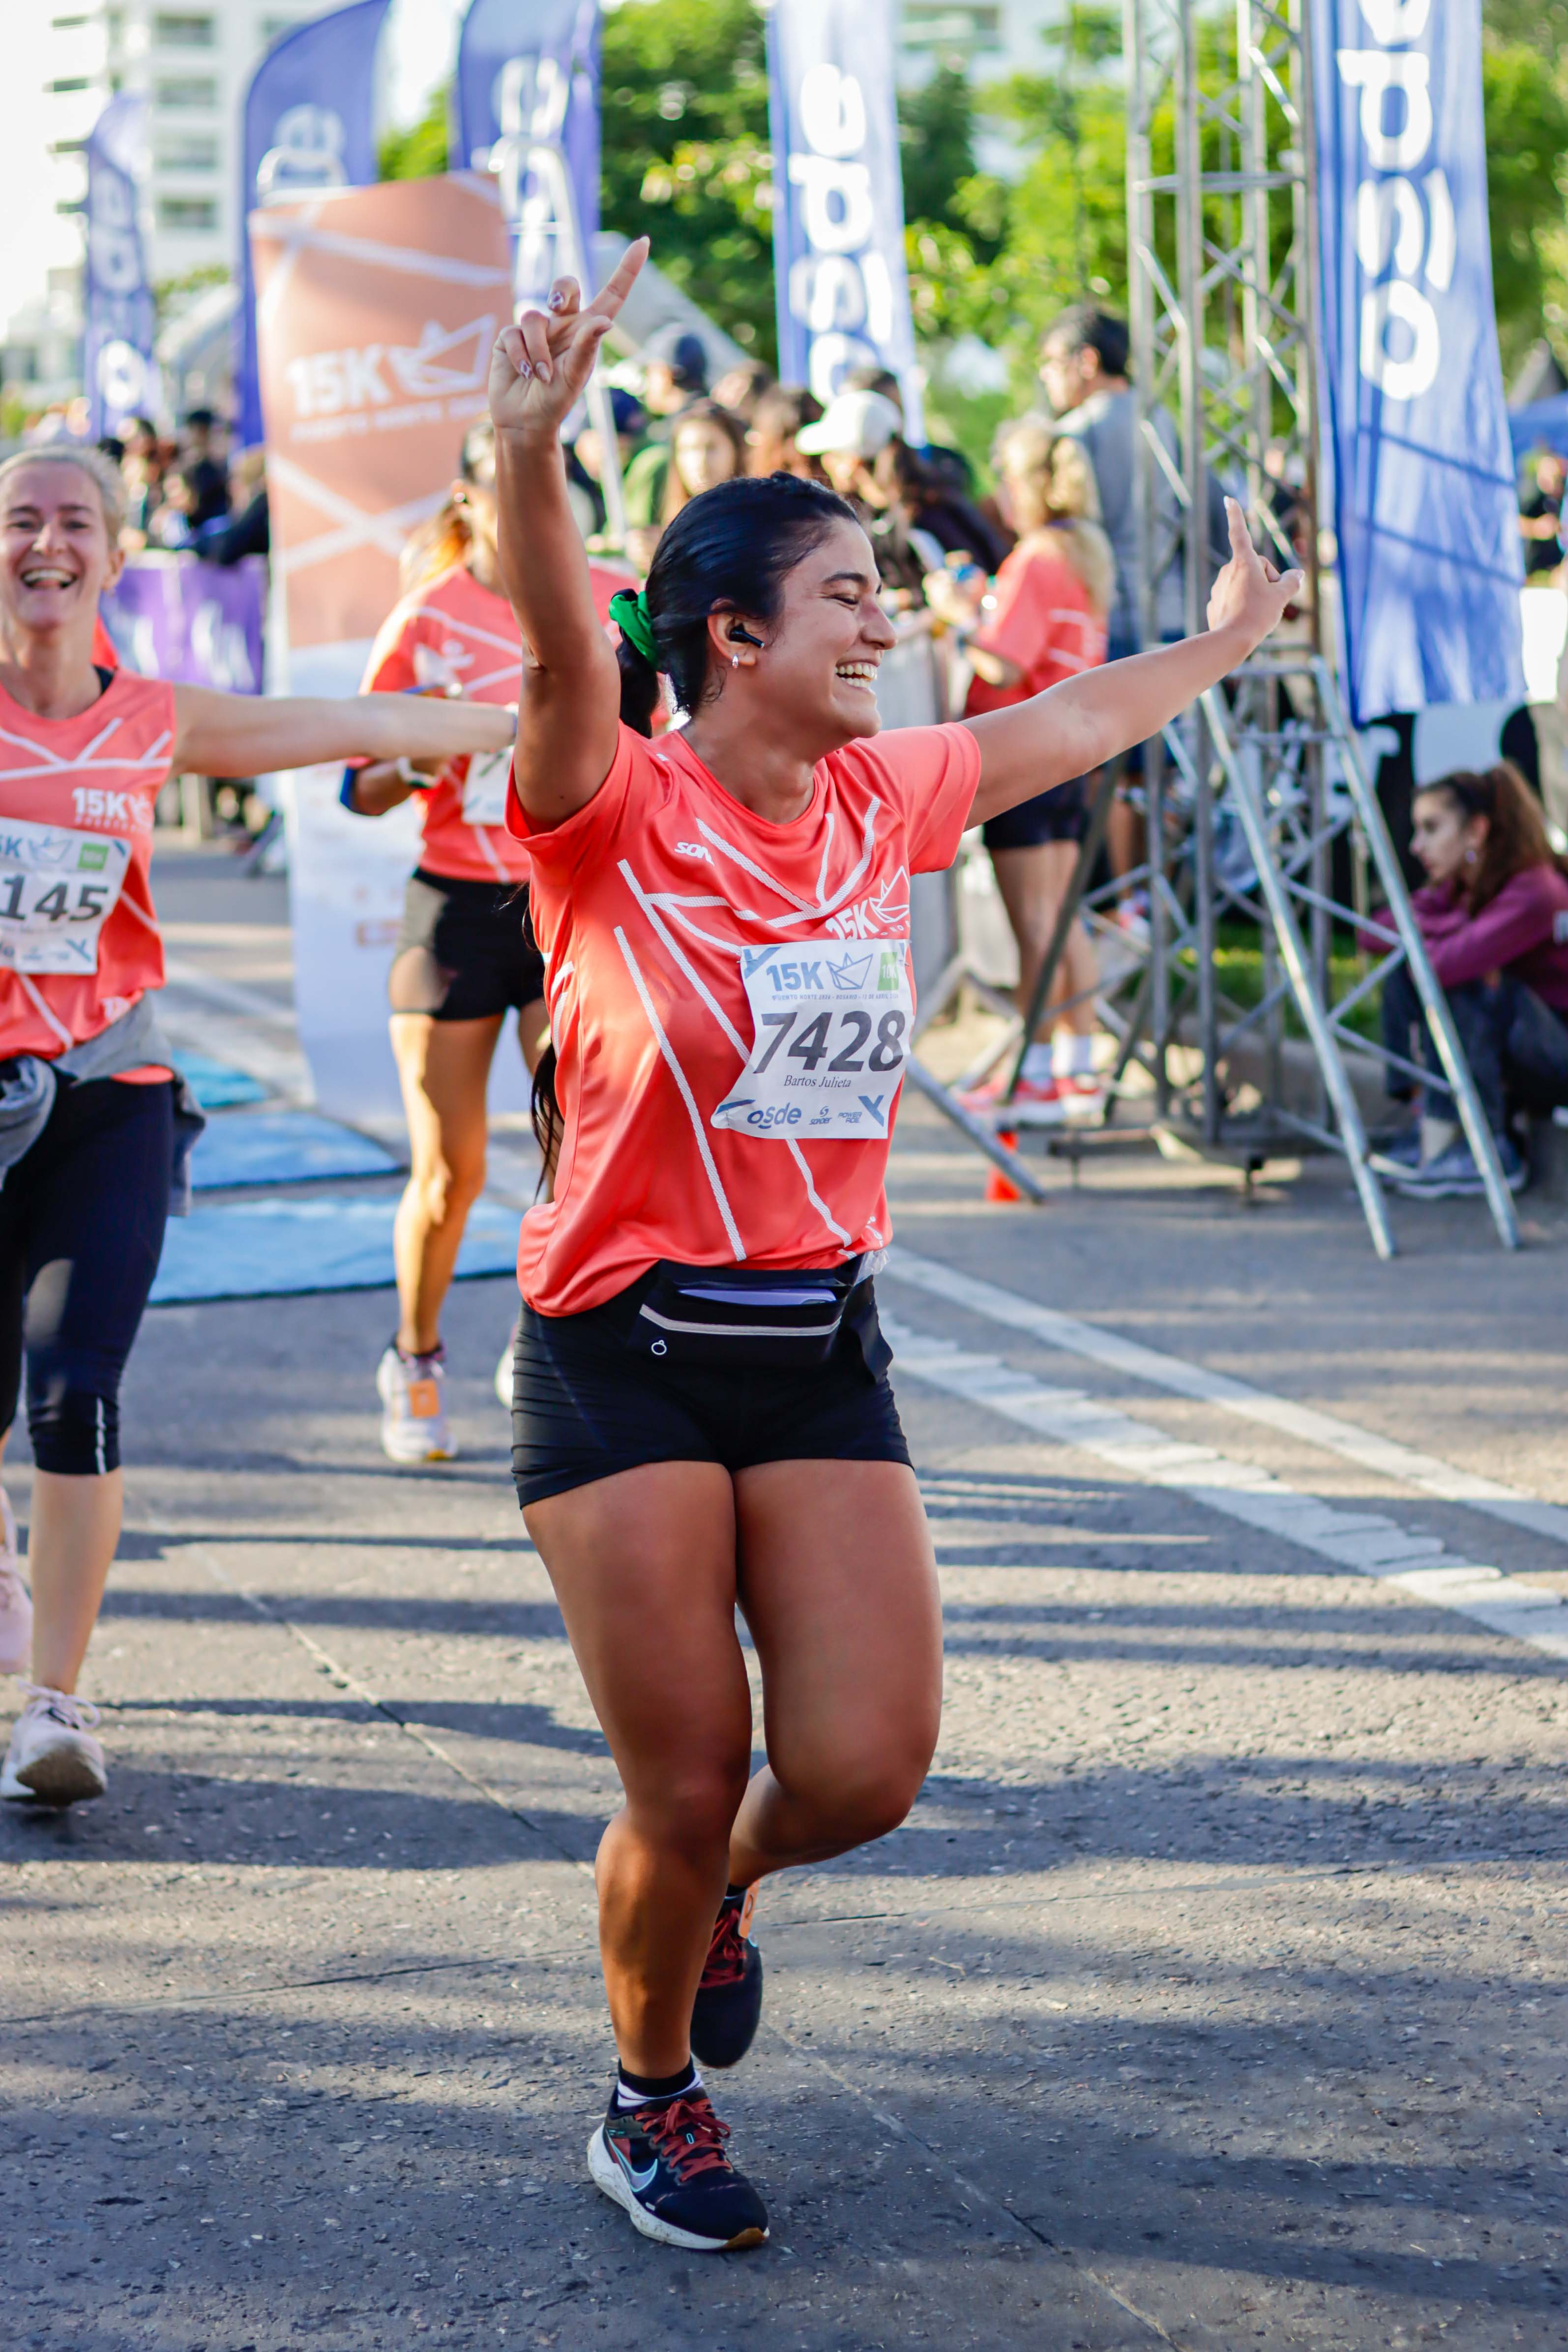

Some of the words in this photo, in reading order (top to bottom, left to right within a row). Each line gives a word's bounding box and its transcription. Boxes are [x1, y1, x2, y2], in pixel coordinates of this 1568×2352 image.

[287, 343, 391, 417] 15K
[72, 787, 127, 820] 15K
[0, 874, 108, 921] 145
[825, 899, 879, 940] 15K
[766, 962, 824, 991] 15K
[753, 1009, 905, 1074] 7428
[784, 1075, 816, 1087] Bartos
[819, 1076, 852, 1088] Julieta
[747, 1103, 802, 1126] osde
